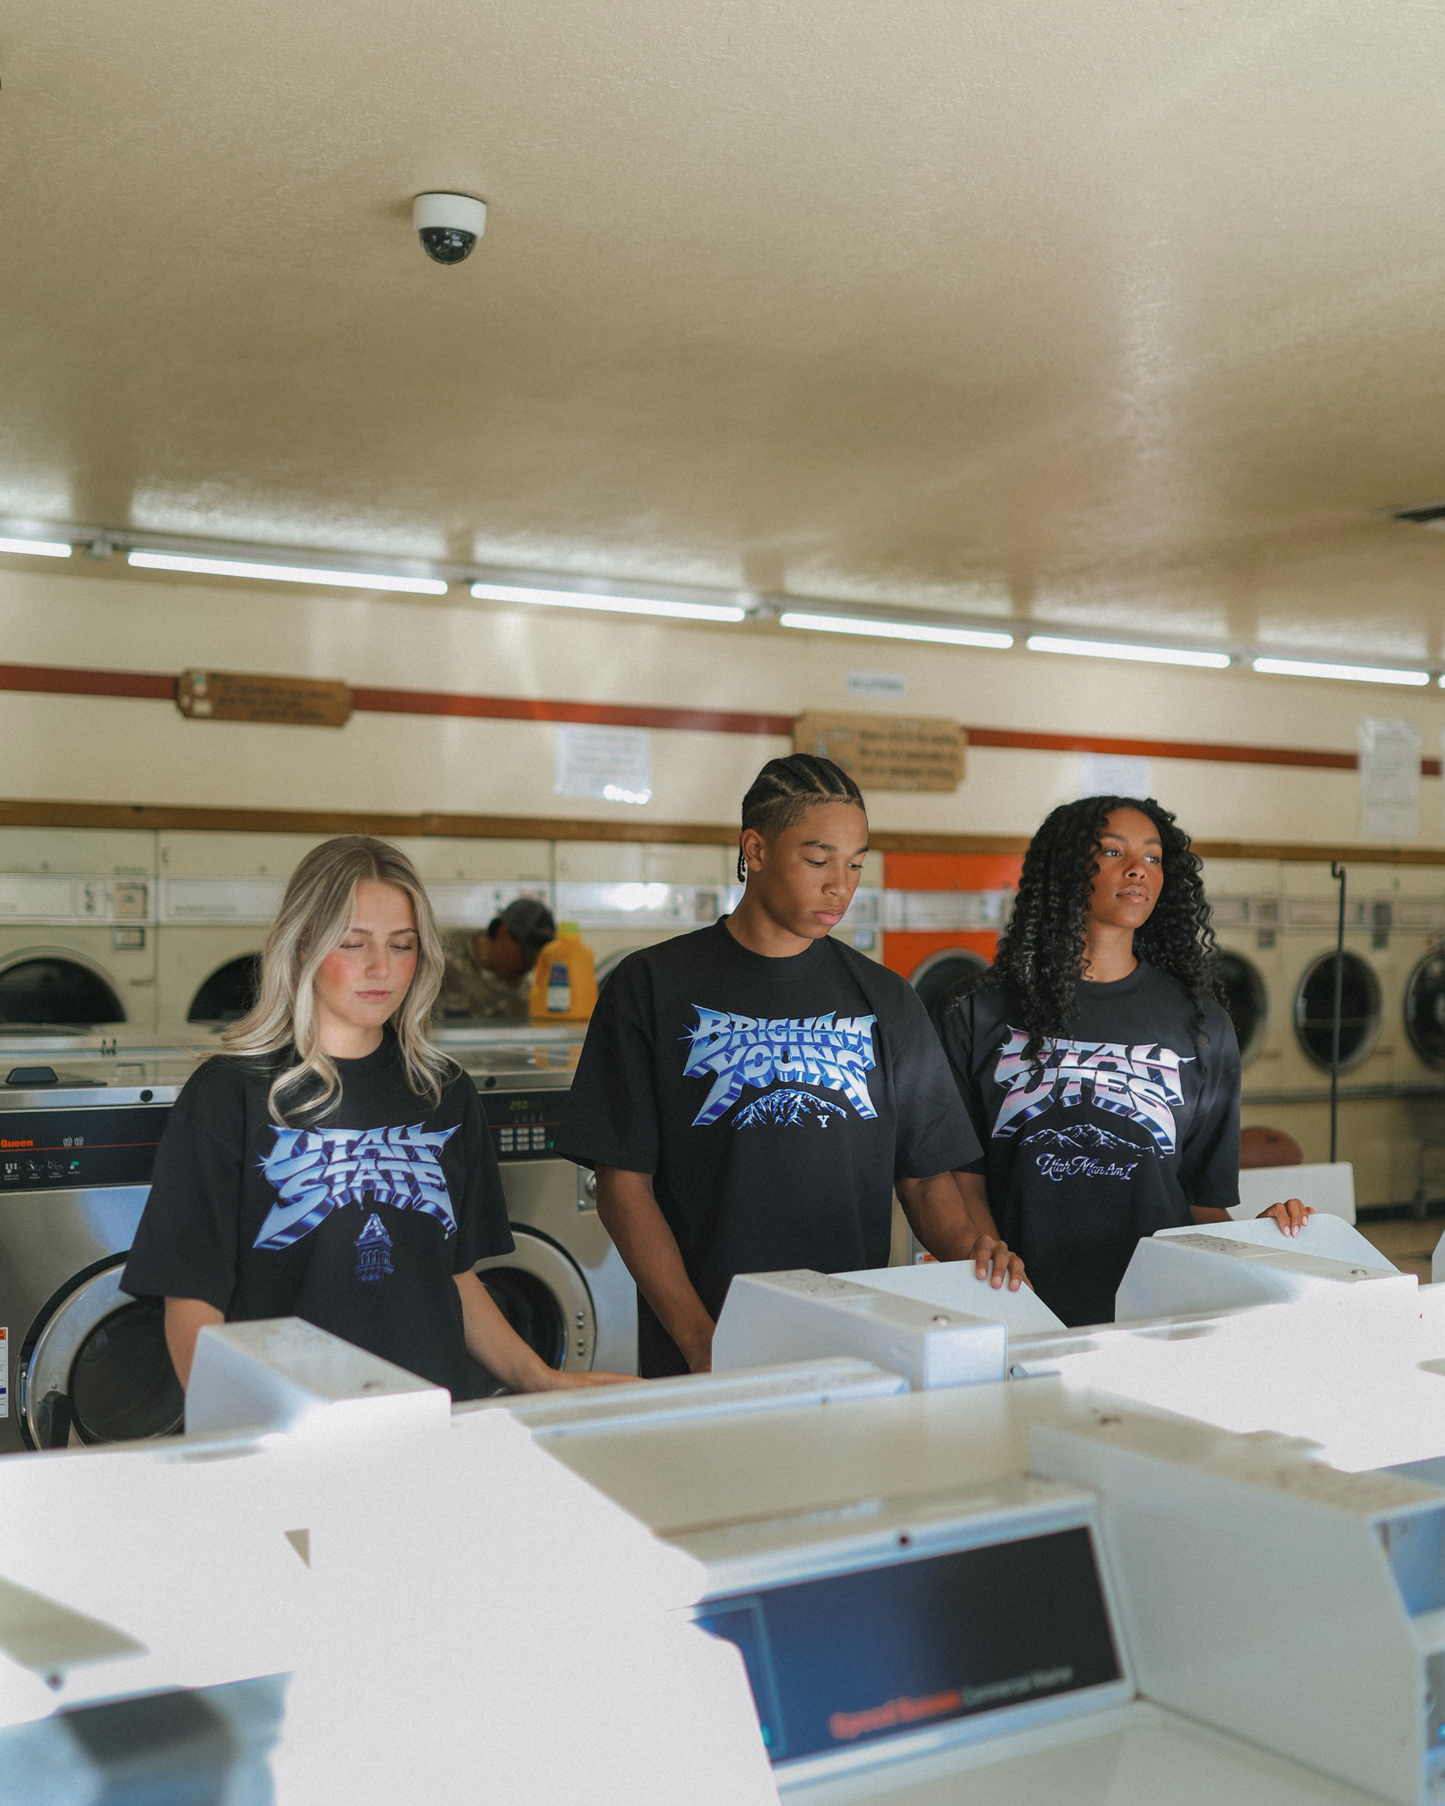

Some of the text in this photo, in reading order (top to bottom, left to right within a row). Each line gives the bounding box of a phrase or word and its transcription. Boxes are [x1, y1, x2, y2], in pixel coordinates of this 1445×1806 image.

[682, 1003, 878, 1078] BRIGHAM
[994, 1024, 1197, 1106] UTAH
[690, 1044, 879, 1127] YOUNG
[817, 1115, 830, 1128] Y
[991, 1066, 1177, 1155] UTES
[0, 1138, 34, 1148] Queen
[264, 1121, 462, 1190] UTAH
[1036, 1153, 1138, 1181] Utah Man Am I
[252, 1158, 458, 1251] STATE
